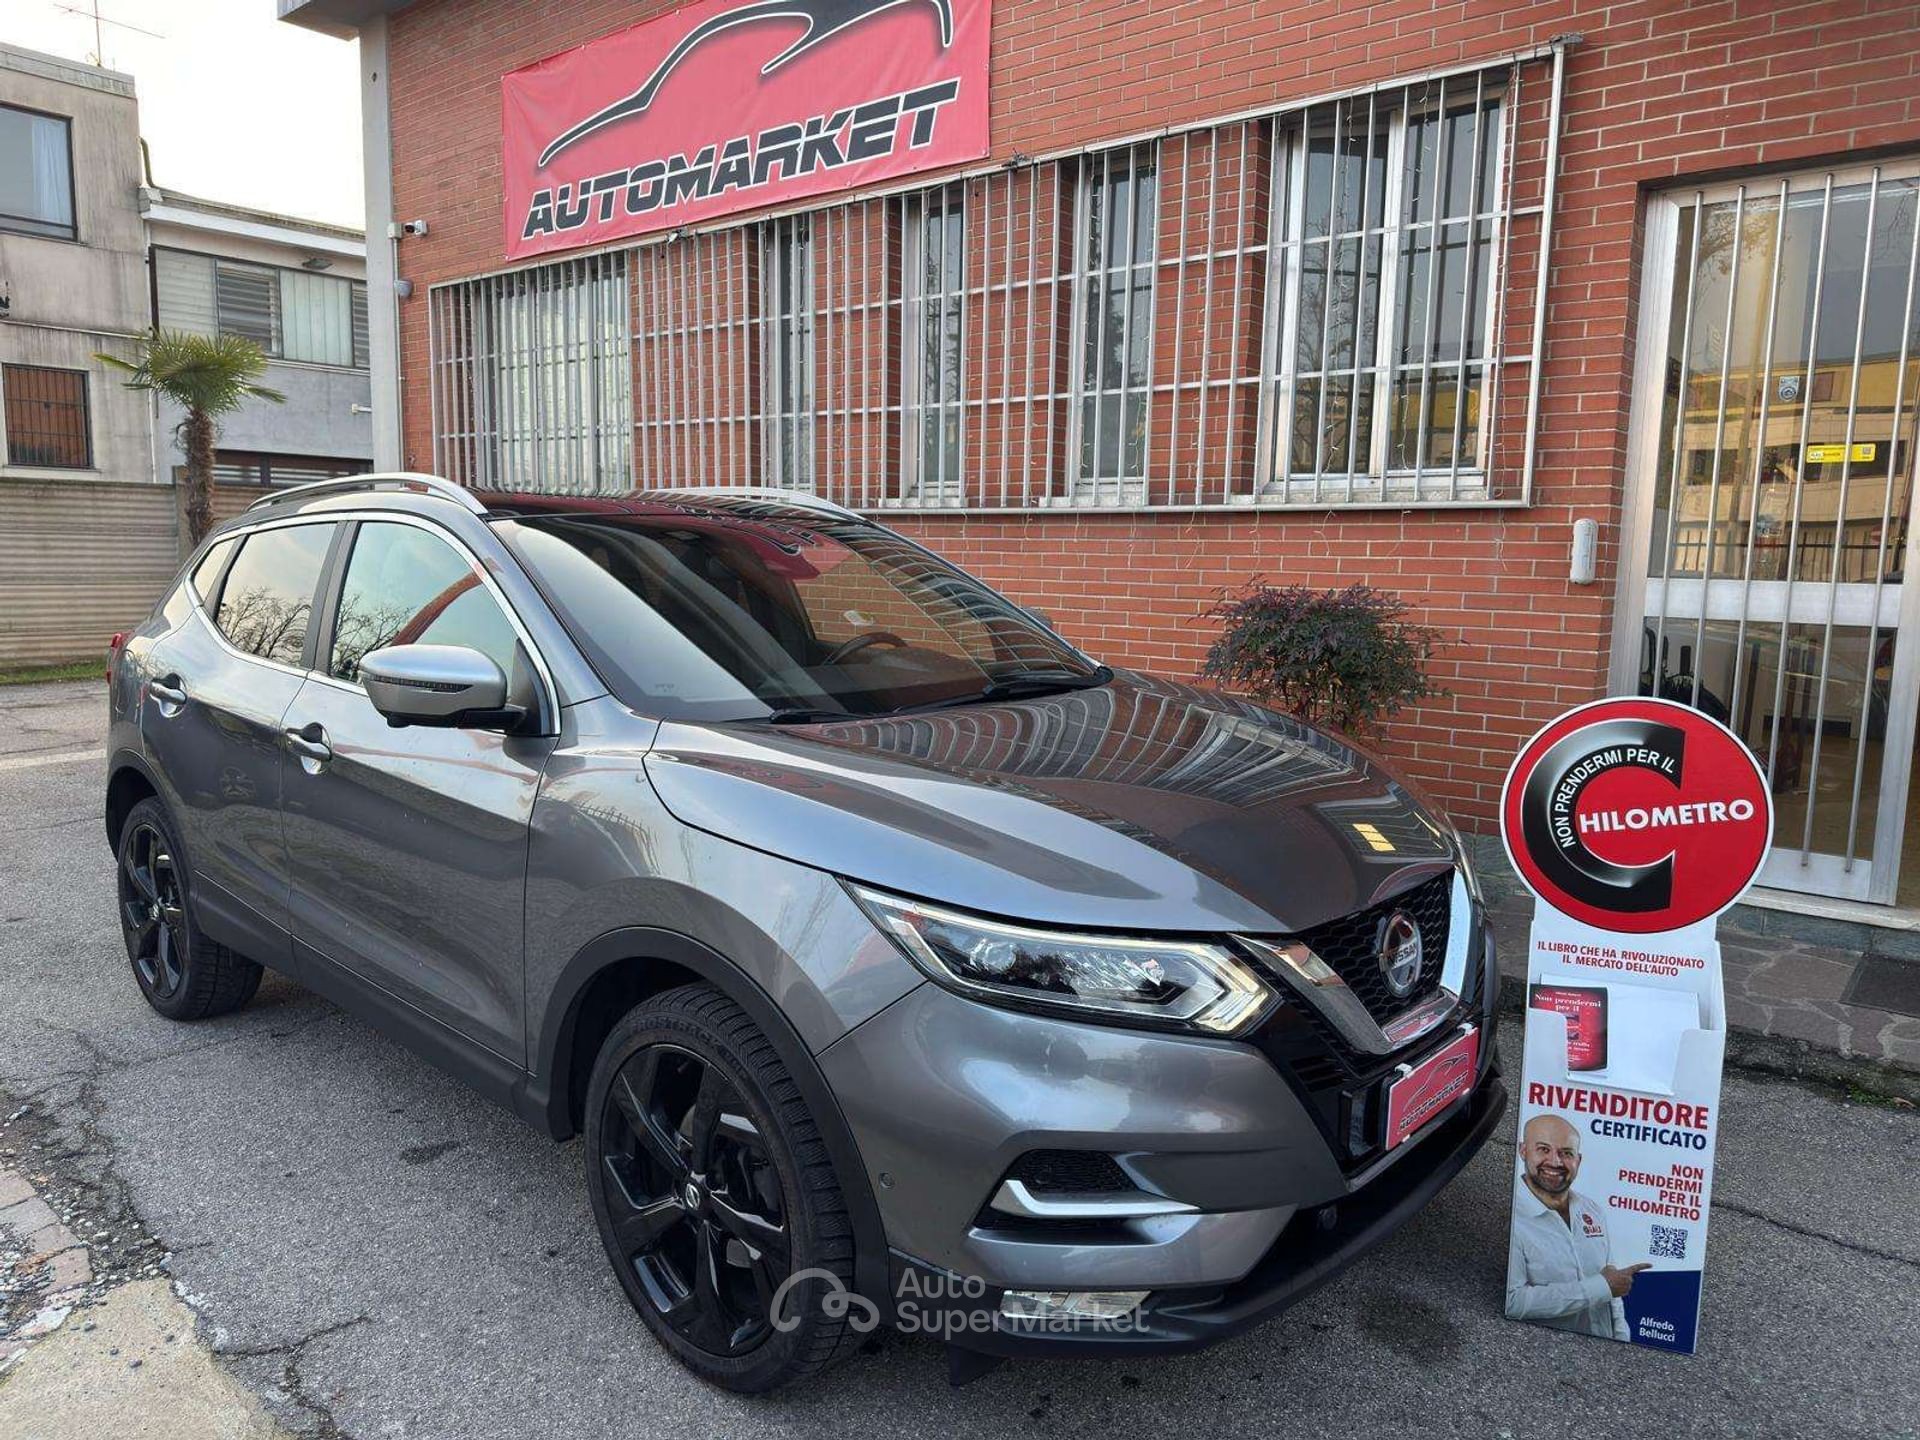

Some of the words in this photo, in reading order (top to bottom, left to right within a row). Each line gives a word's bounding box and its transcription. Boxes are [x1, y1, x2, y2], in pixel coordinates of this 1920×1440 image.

[521, 77, 961, 240] AUTOMARKET
[1626, 748, 1660, 764] PER
[1660, 756, 1675, 774] IL
[1554, 749, 1623, 813] PRENDERMI
[1579, 798, 1754, 833] HILOMETRO
[1554, 815, 1576, 848] NON
[1537, 941, 1546, 950] IL
[1548, 942, 1578, 954] LIBRO
[1580, 946, 1600, 957] CHE
[1601, 949, 1617, 958] HA
[1621, 951, 1705, 969] RIVOLUZIONATO
[1562, 954, 1572, 964] IL
[1575, 956, 1623, 970] MERCATO
[1625, 961, 1679, 977] DELL'AUTO
[1528, 1082, 1709, 1131] RIVENDITORE
[1590, 1118, 1707, 1151] CERTIFICATO
[1618, 1169, 1703, 1193] PRENDERMI
[1671, 1163, 1704, 1180] NON
[1608, 1195, 1701, 1221] CHILOMETRO
[1659, 1190, 1686, 1206] PER
[1689, 1194, 1702, 1208] IL
[1639, 1316, 1675, 1331] Alfredo
[1639, 1327, 1676, 1342] Bellucci
